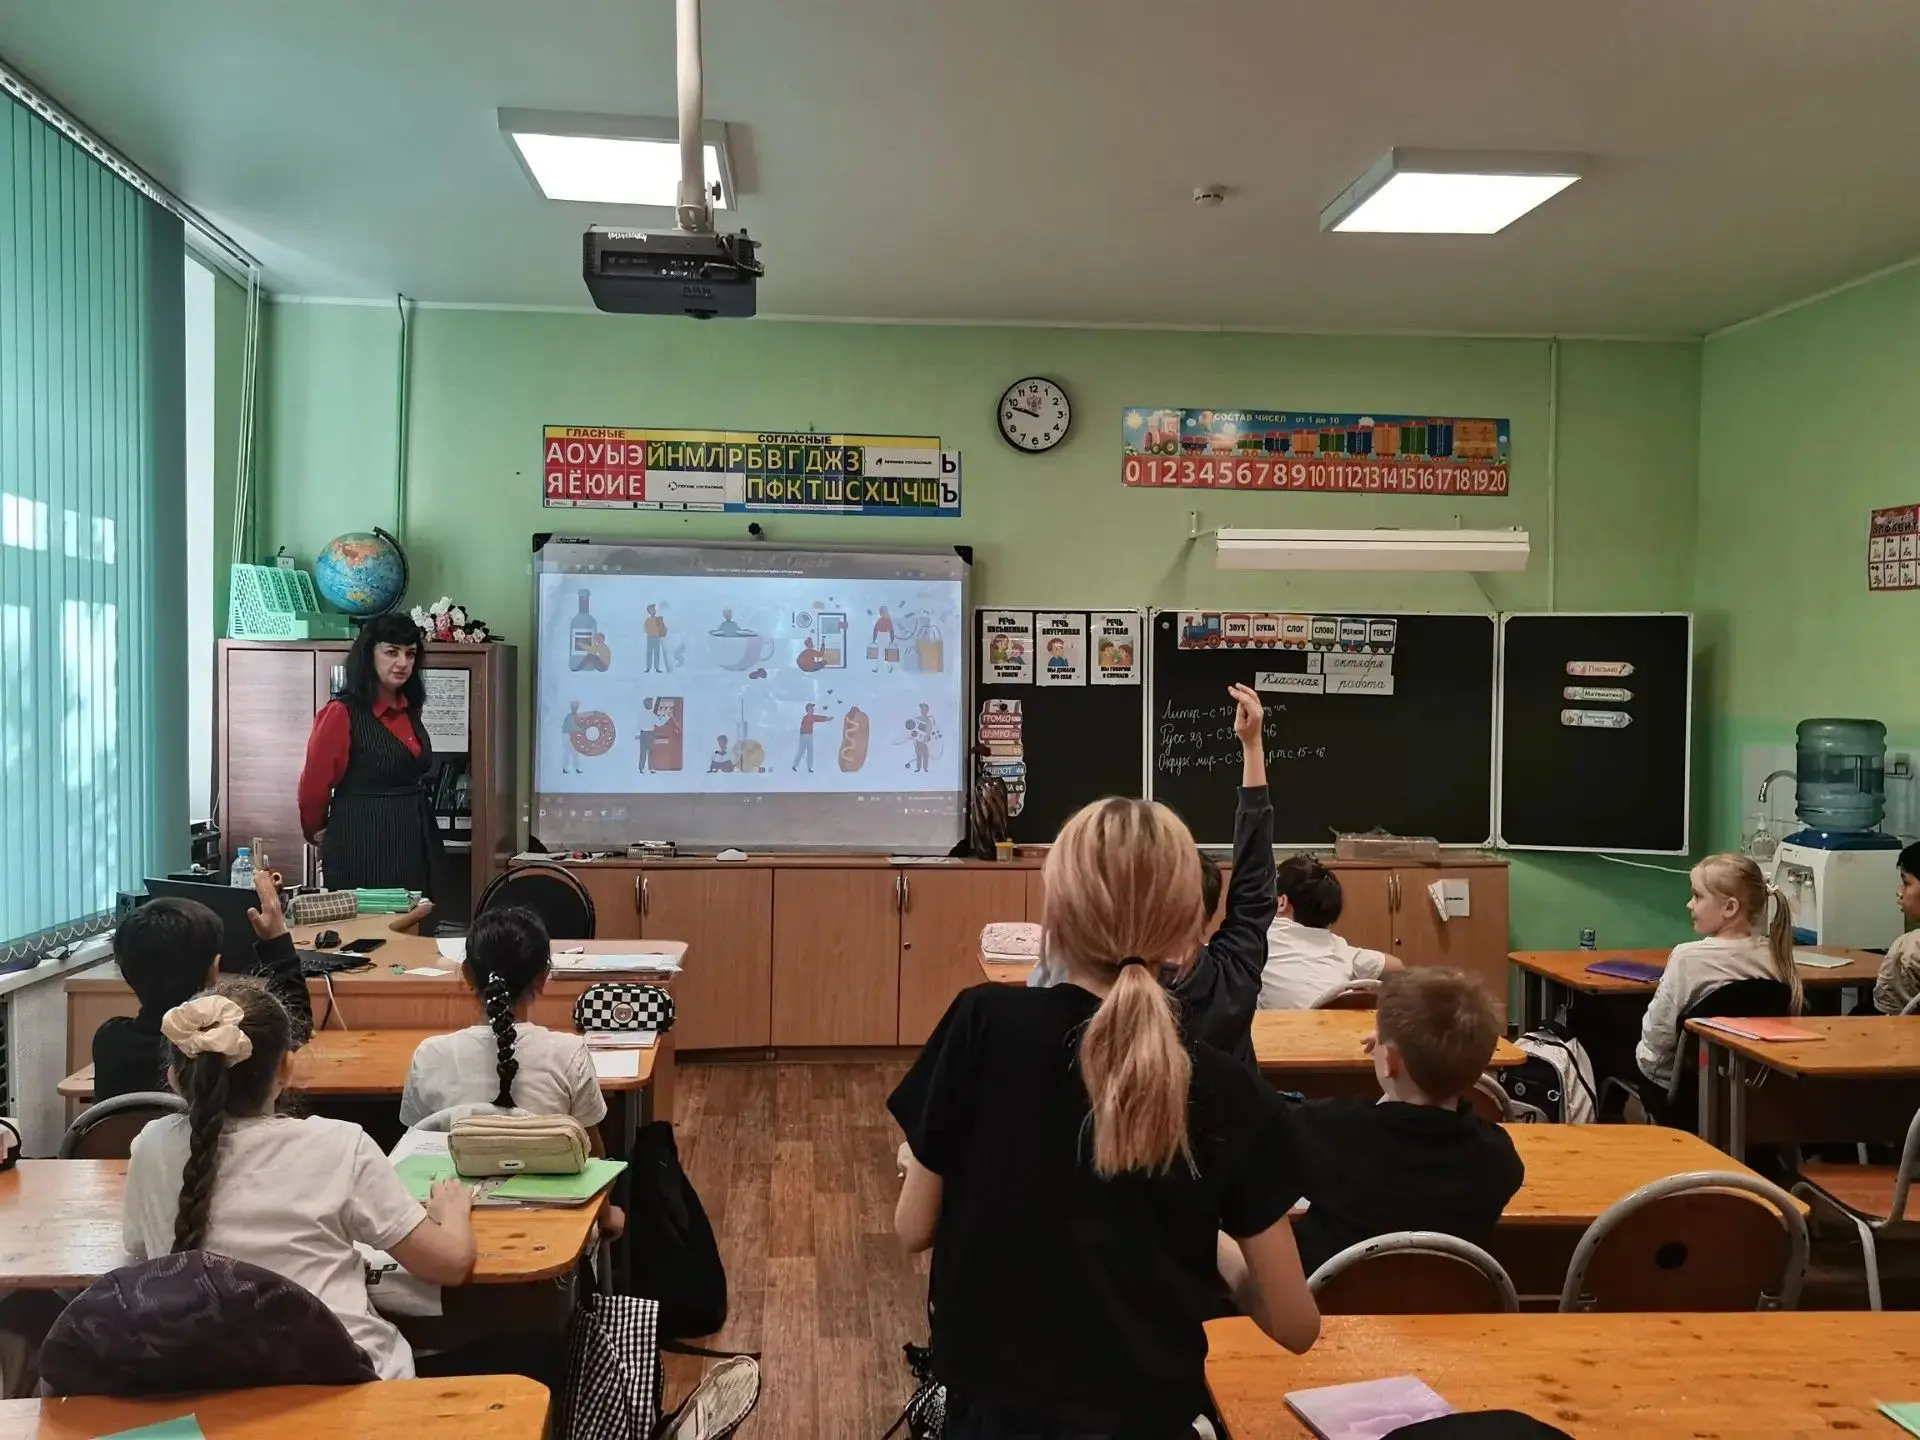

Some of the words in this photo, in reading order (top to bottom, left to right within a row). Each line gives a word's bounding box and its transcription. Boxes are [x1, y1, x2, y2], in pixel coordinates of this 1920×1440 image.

[1018, 389, 1025, 397] 11
[1029, 385, 1039, 393] 12
[1009, 398, 1018, 407] 10
[1053, 397, 1059, 405] 2
[1006, 411, 1013, 419] 9
[1057, 411, 1063, 419] 3
[1255, 414, 1286, 423] ЧИСЕЛ
[1010, 425, 1016, 433] 8
[1053, 423, 1059, 431] 4
[566, 428, 626, 438] ГЛАСНЫЕ
[1044, 432, 1050, 441] 5
[758, 434, 832, 445] СОГЛАСНЫЕ
[1020, 433, 1026, 442] 7
[1032, 437, 1039, 445] 6
[1106, 618, 1124, 626] РЕЧЬ
[1315, 626, 1334, 635] СЛОВО
[1373, 629, 1392, 637] ТЕКСТ
[1262, 673, 1319, 687] Классная
[1337, 674, 1385, 692] работа
